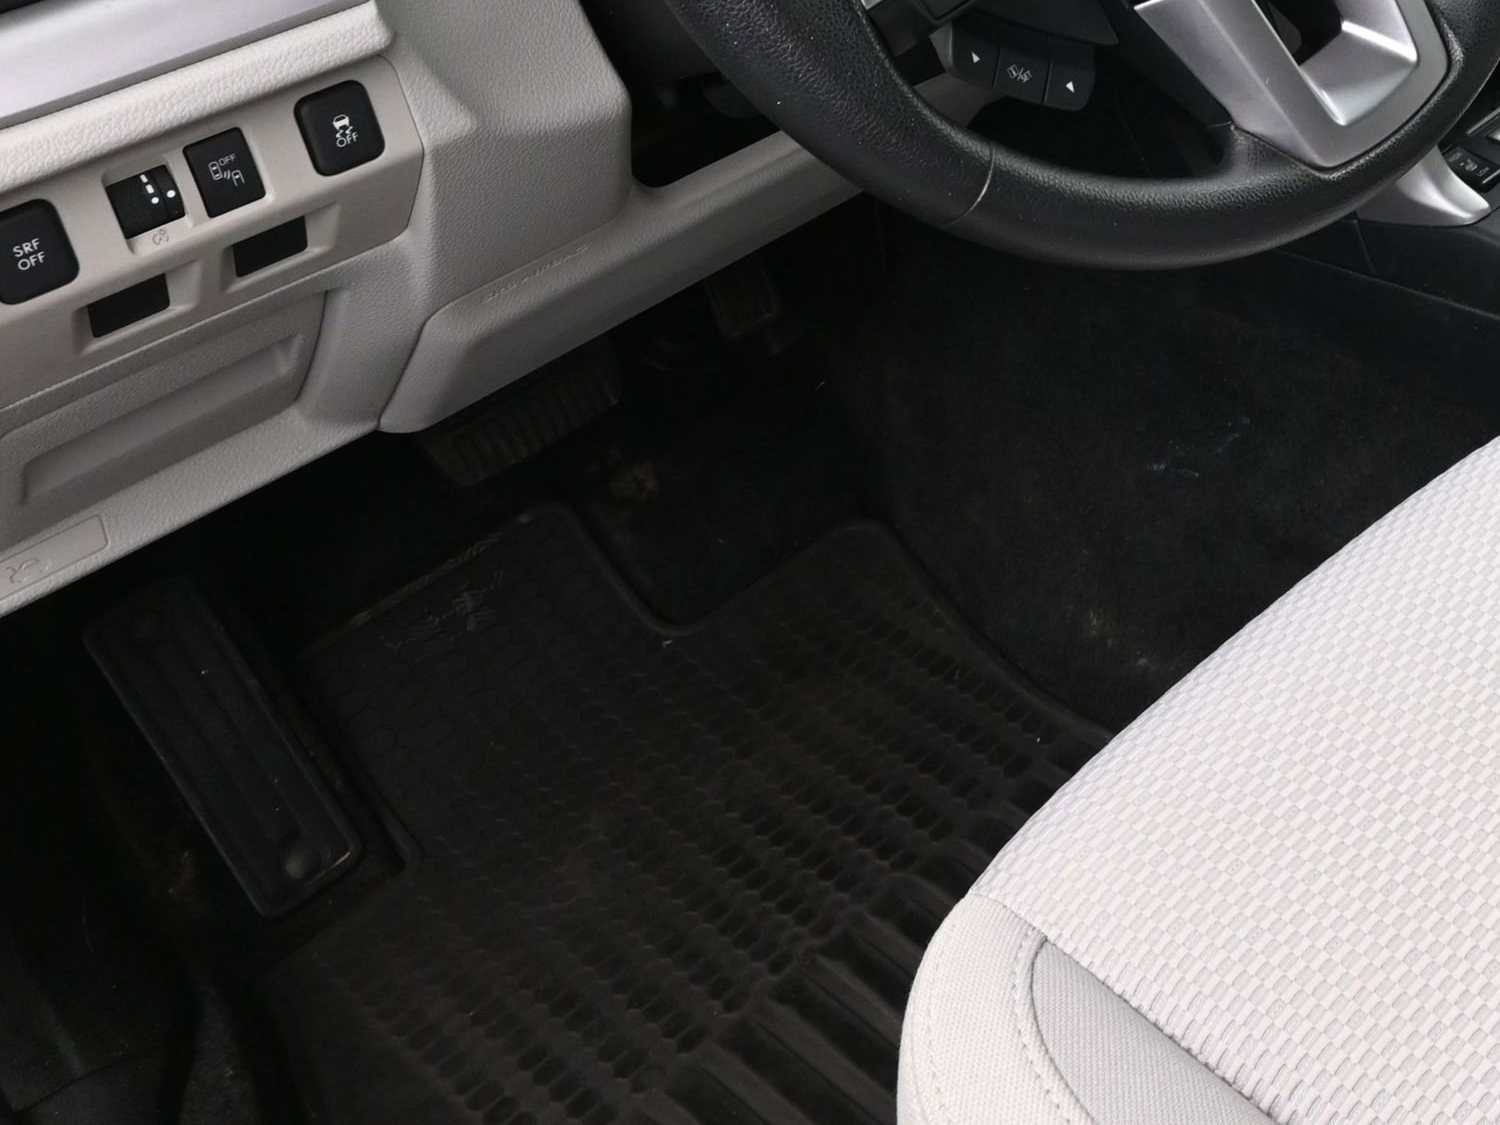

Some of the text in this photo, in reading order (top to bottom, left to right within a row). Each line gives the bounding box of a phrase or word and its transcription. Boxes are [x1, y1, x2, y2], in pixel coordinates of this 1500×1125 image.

[335, 131, 359, 148] OFF
[218, 153, 237, 167] OFF
[12, 237, 40, 258] SRF
[17, 250, 46, 272] OFF
